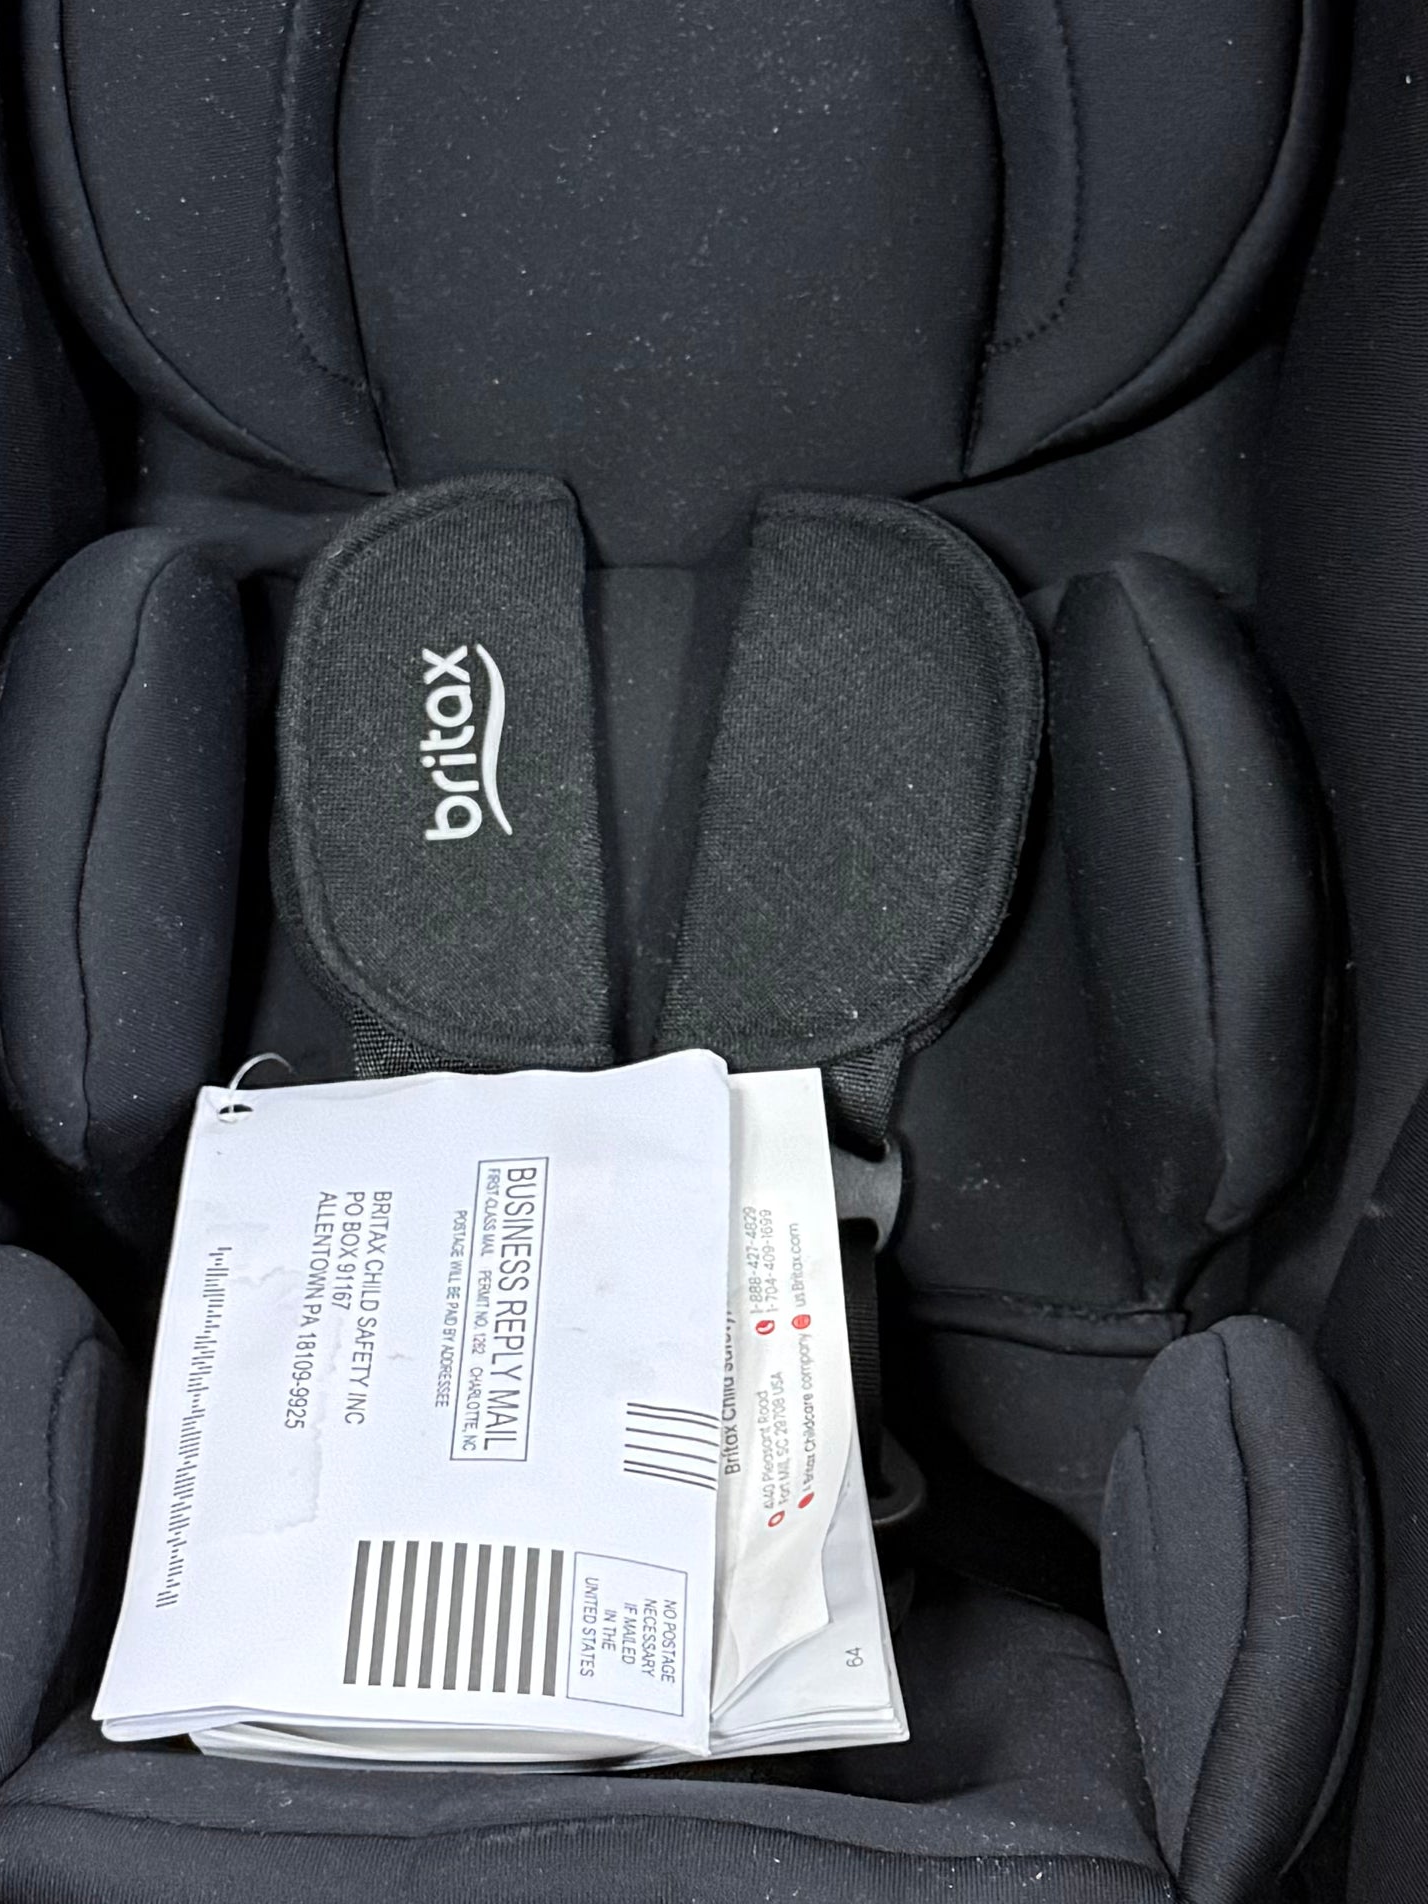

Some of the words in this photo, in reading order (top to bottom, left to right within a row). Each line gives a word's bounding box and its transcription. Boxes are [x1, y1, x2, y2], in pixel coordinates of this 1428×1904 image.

[419, 644, 483, 841] britax
[343, 1190, 365, 1216] PO
[366, 1190, 393, 1254] BRITAX
[303, 1190, 338, 1300] ALLENTOWN
[337, 1221, 362, 1259] BOX
[497, 1166, 537, 1291] BUSINESS
[331, 1262, 356, 1310] 91167
[359, 1258, 384, 1311] CHILD
[299, 1303, 322, 1327] PA
[348, 1315, 377, 1387] SAFETY
[489, 1299, 528, 1381] REPLY
[284, 1331, 317, 1429] 18109-9925
[343, 1391, 367, 1425] INC
[482, 1389, 520, 1451] MAIL
[461, 1434, 477, 1451] NC
[582, 1576, 599, 1624] UNITED
[603, 1608, 617, 1622] IN
[623, 1601, 638, 1615] IF
[662, 1598, 677, 1619] NO
[579, 1626, 596, 1677] STATES
[600, 1626, 617, 1651] THE
[620, 1616, 637, 1665] MAILED
[640, 1597, 657, 1677] NECESSARY
[660, 1621, 676, 1684] POSTAGE
[845, 1646, 864, 1667] 64
